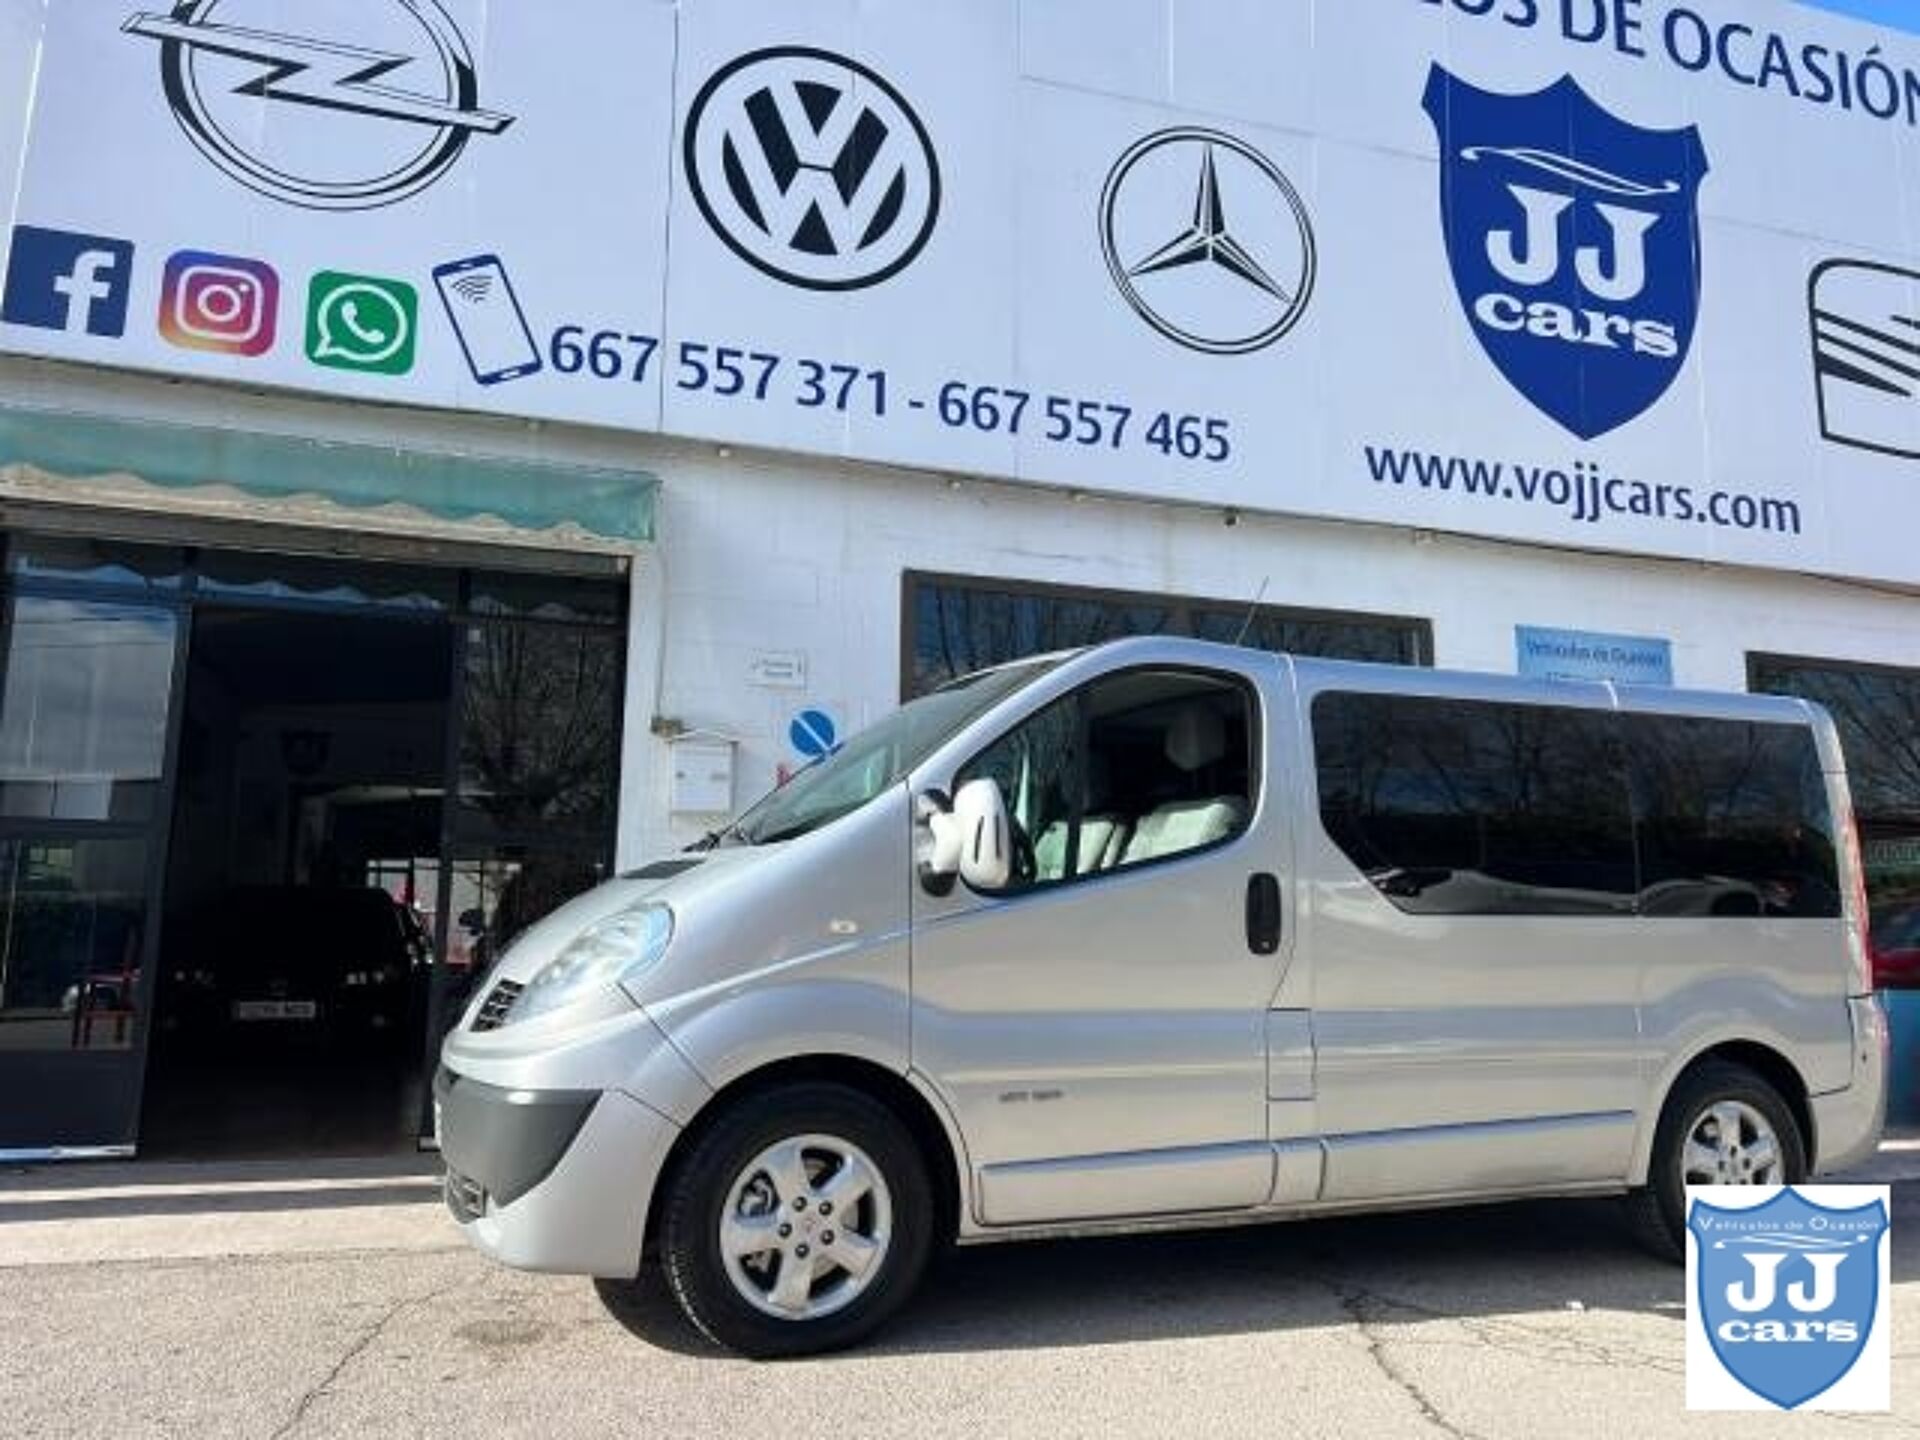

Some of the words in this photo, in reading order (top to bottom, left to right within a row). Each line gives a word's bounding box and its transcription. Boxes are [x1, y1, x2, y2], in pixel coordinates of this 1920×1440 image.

[1560, 0, 1646, 58] DE
[1486, 183, 1661, 301] JJ
[1473, 293, 1679, 358] cars
[550, 325, 660, 383] 667
[677, 342, 781, 401] 557
[797, 359, 887, 416] 371
[938, 381, 1031, 434] 667
[1046, 396, 1133, 449] 557
[1145, 412, 1231, 462] 465
[1364, 445, 1801, 534] www.vojjcars.com
